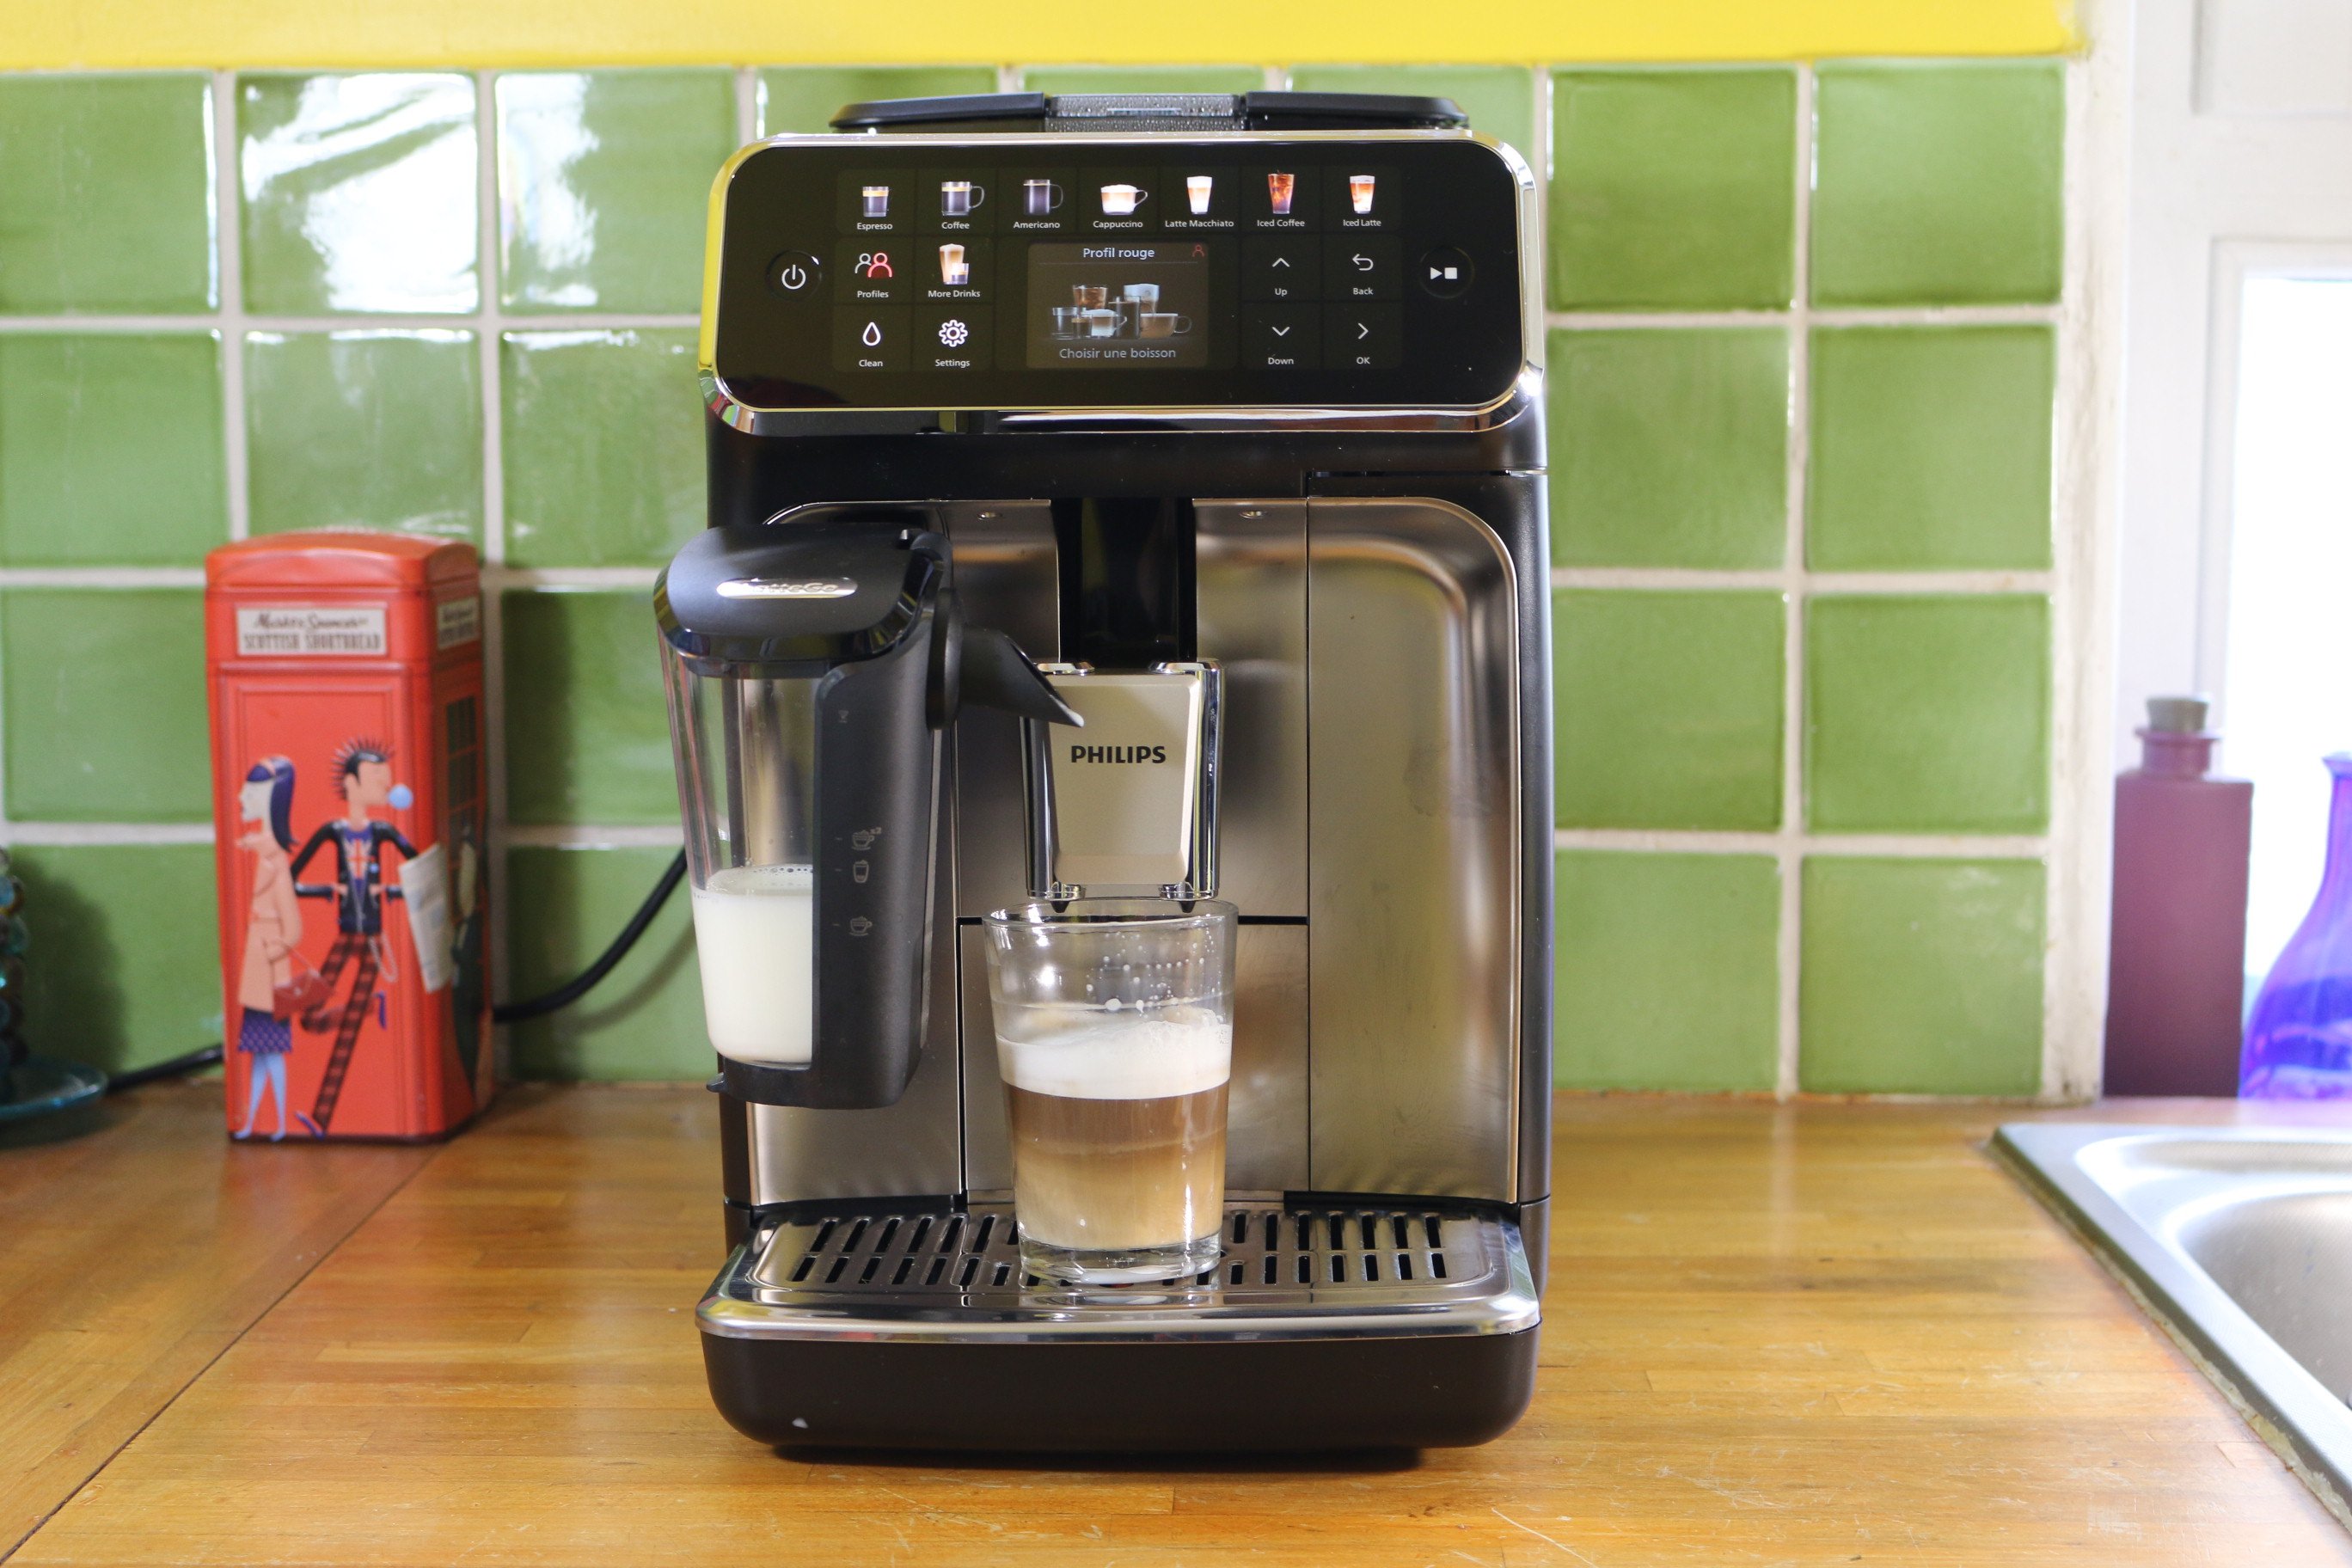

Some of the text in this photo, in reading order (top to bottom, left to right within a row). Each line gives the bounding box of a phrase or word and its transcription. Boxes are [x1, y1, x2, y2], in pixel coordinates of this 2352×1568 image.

[856, 222, 893, 232] Espresso
[940, 220, 971, 230] Coffee
[1013, 220, 1061, 229] Americano
[1092, 220, 1144, 230] Cappuccino
[1164, 219, 1234, 228] Latte Macchiato
[1256, 218, 1306, 227] Iced Coffee
[1342, 218, 1382, 227] Iced Latte
[1082, 247, 1156, 261] Profil rouge
[856, 289, 890, 298] Profiles
[928, 289, 981, 298] More Drinks
[1274, 287, 1289, 298] Up
[1352, 286, 1375, 296] Back
[1058, 346, 1177, 359] Choisir une boisson
[858, 358, 884, 368] Clean
[934, 358, 971, 369] Settings
[1267, 356, 1295, 365] Down
[1355, 356, 1372, 365] OK
[1070, 744, 1167, 765] PHILIPS
